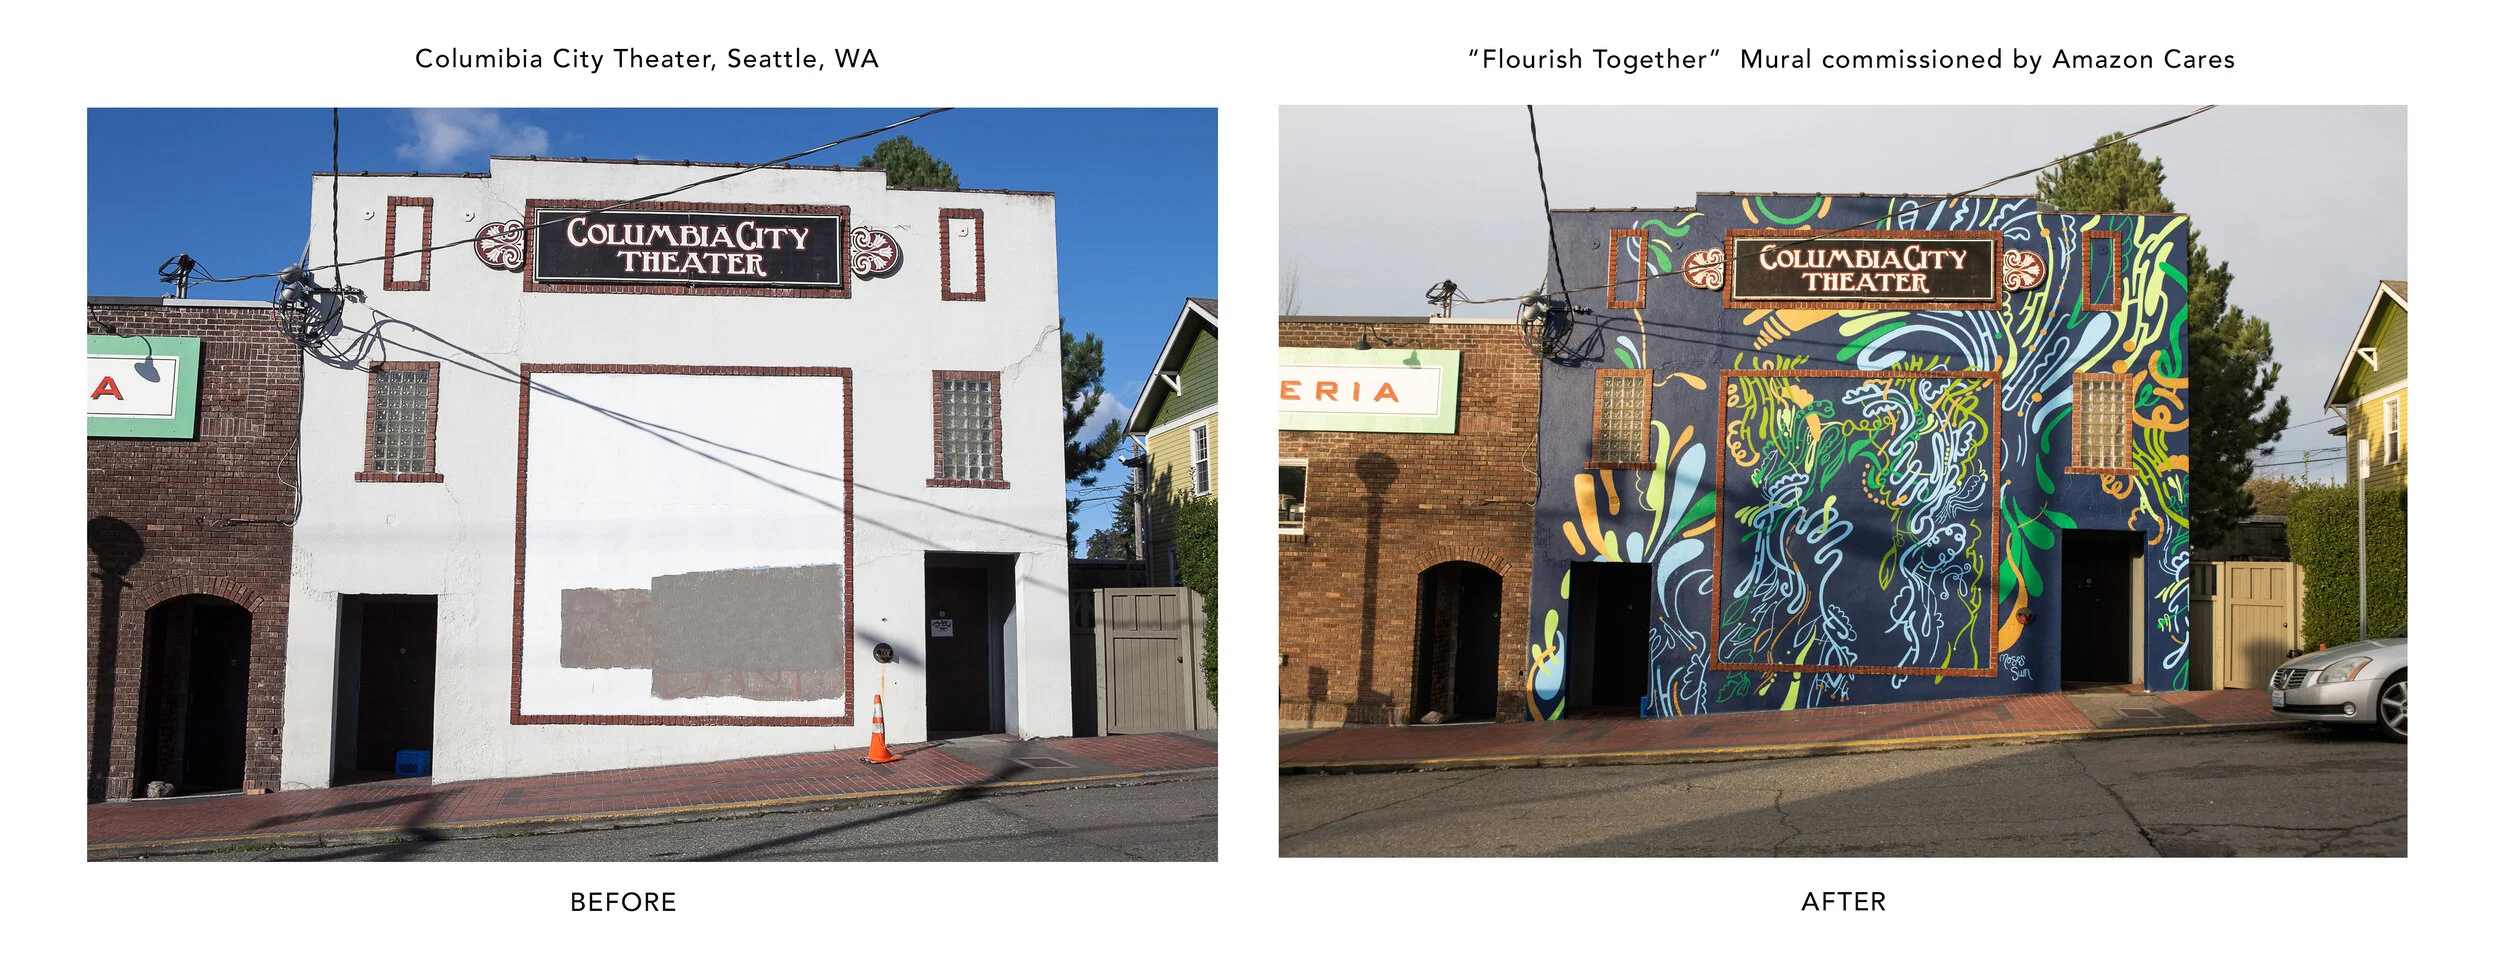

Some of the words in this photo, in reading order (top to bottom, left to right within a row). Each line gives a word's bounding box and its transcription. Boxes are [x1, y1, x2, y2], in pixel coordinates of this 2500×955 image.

[617, 250, 767, 277] THEATER
[1802, 272, 1930, 294] THEATER
[1280, 380, 1400, 402] ERIA
